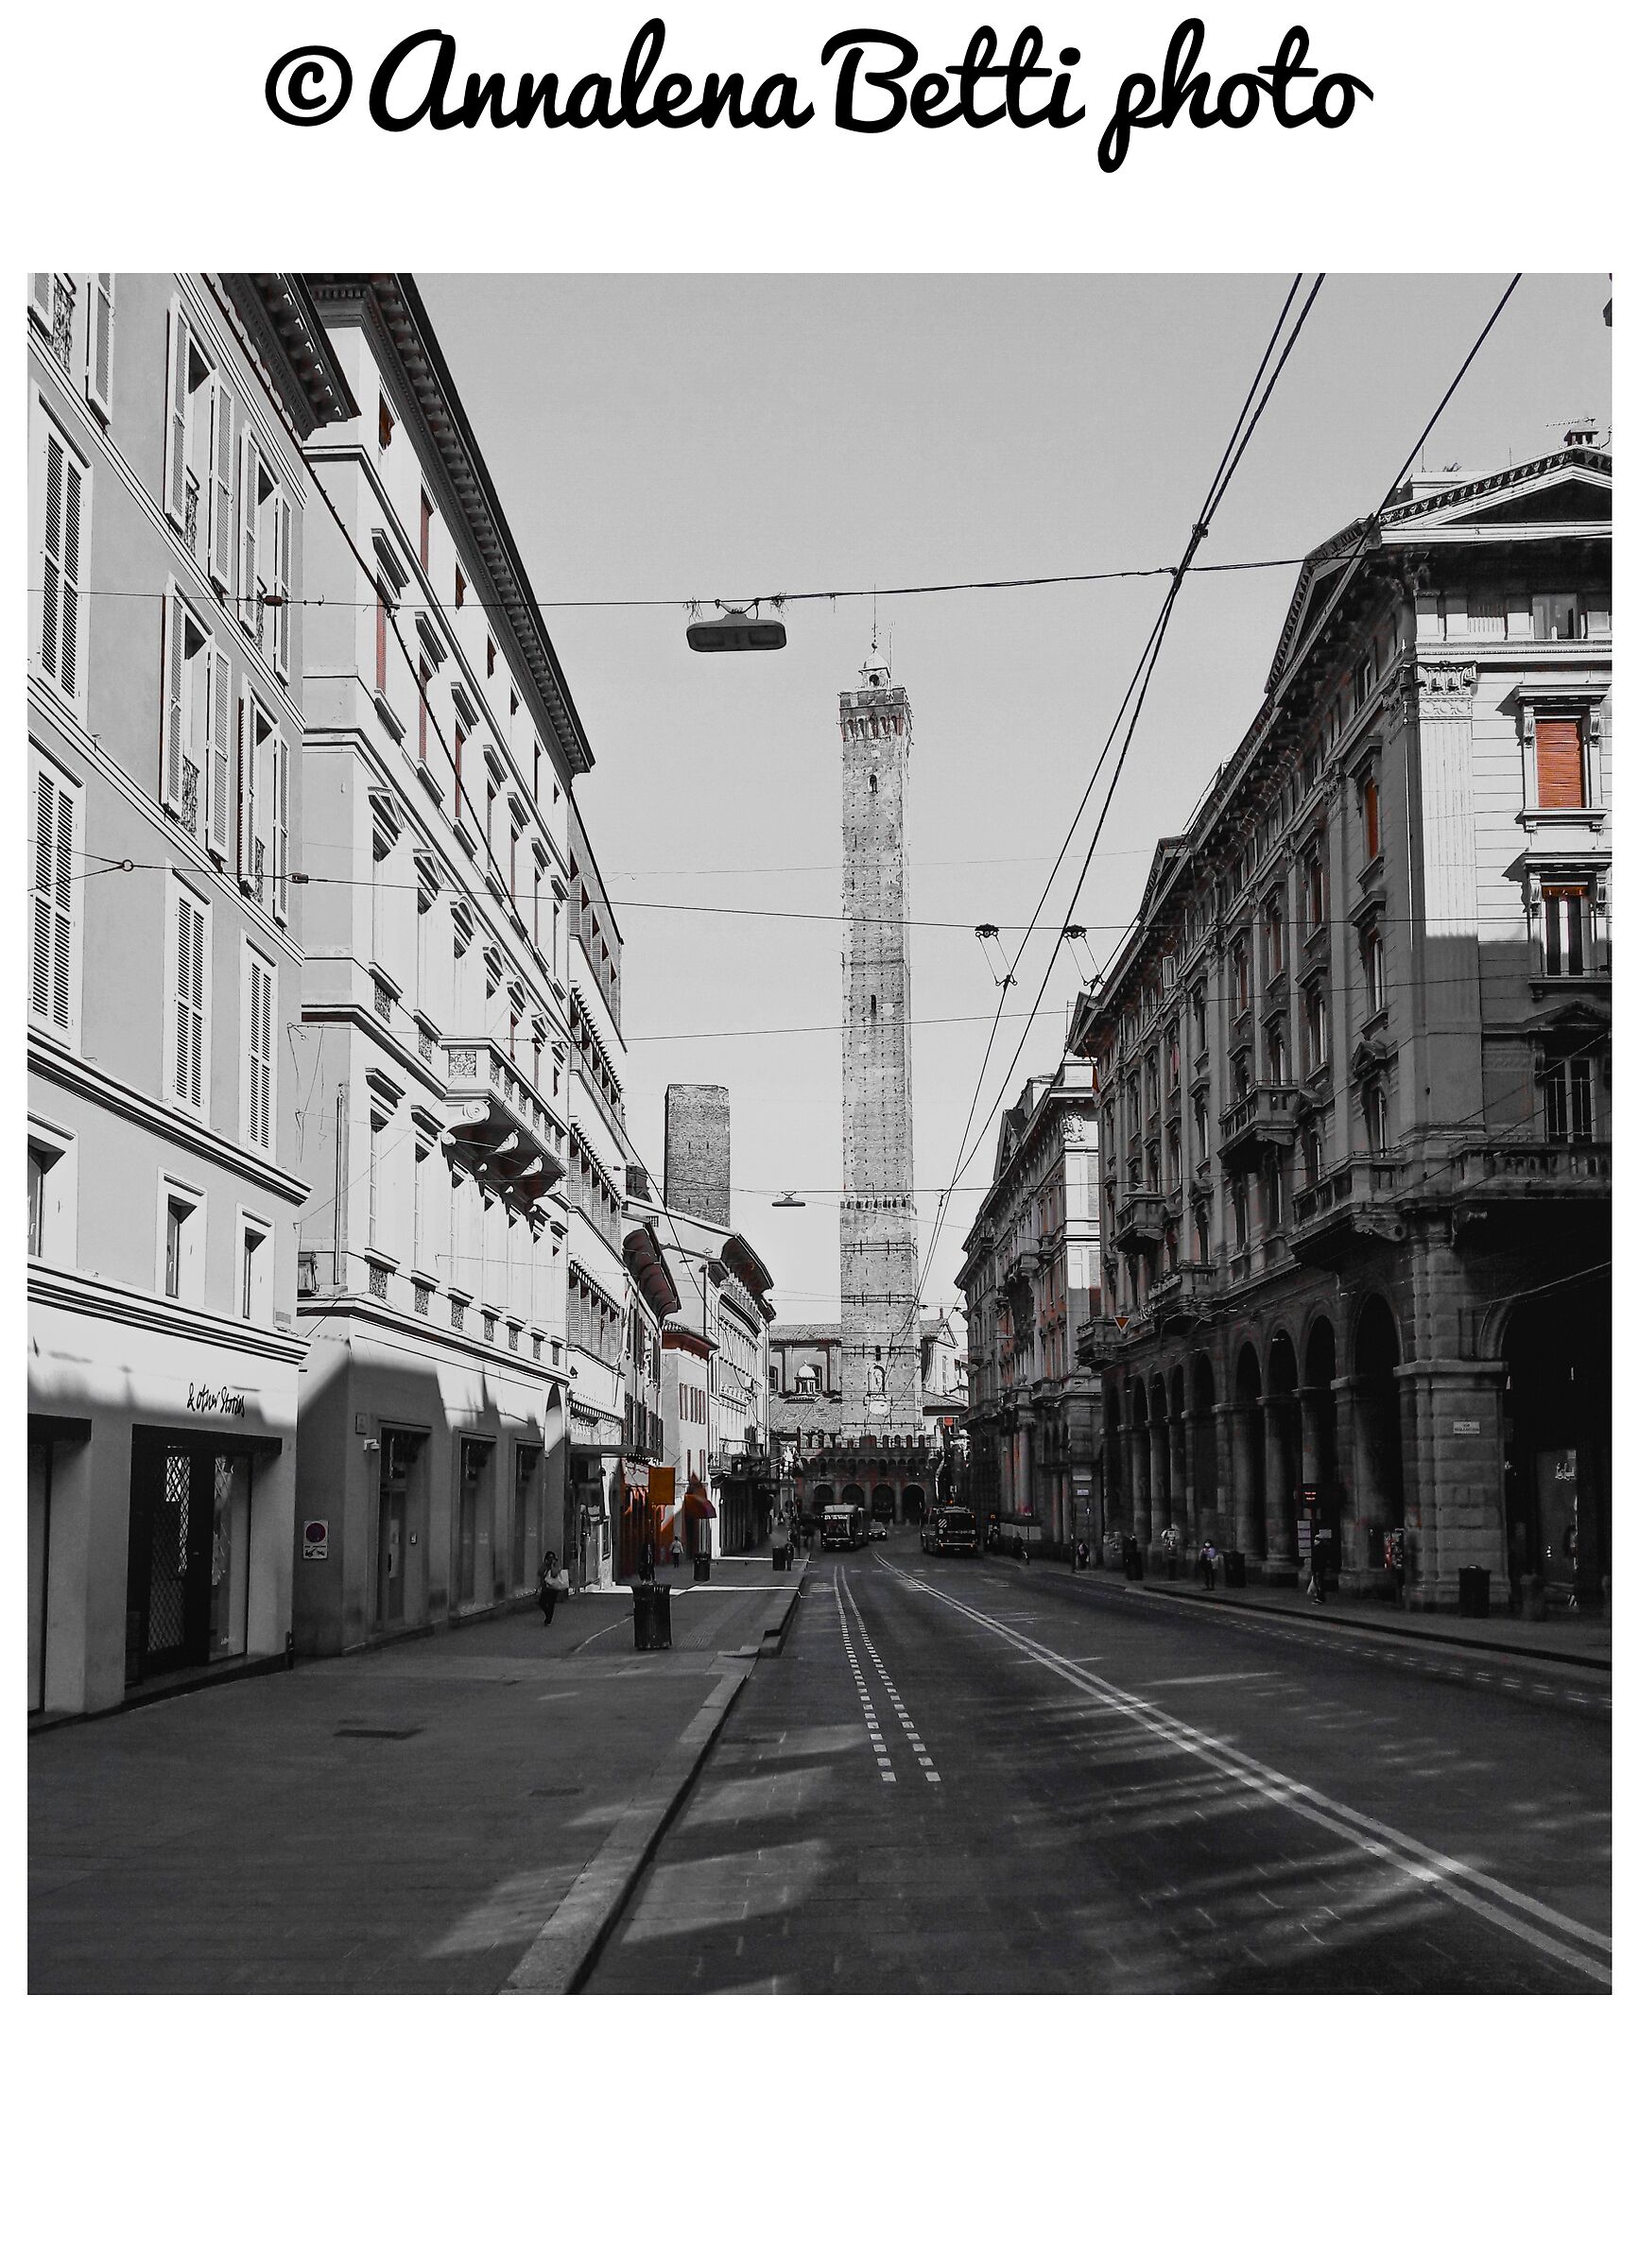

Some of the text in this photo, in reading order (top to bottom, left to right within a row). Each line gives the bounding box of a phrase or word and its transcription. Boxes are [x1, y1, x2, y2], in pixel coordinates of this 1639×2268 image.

[187, 1383, 245, 1418] & other Stories
